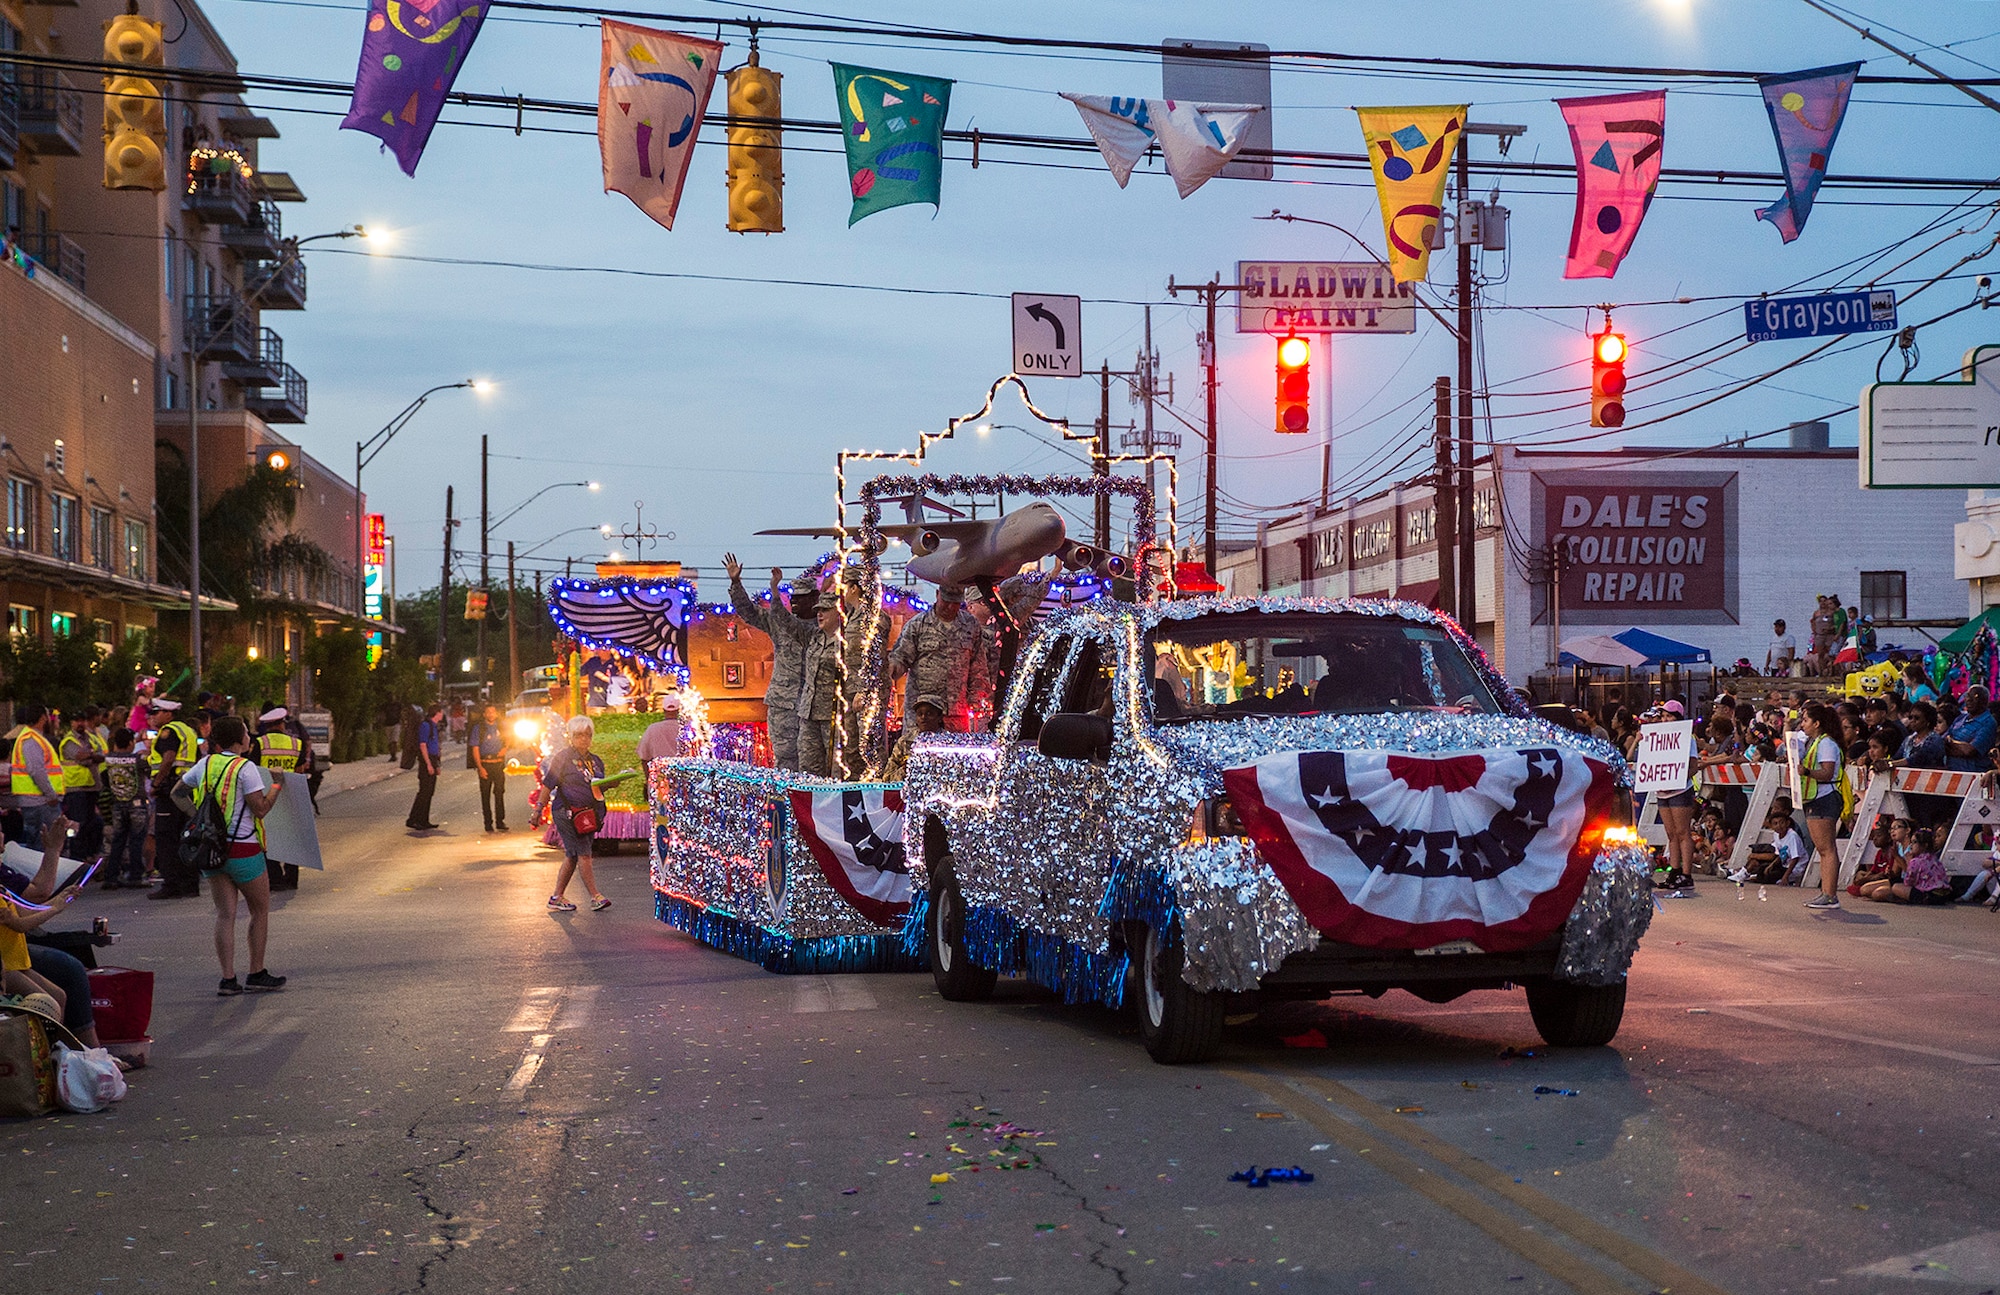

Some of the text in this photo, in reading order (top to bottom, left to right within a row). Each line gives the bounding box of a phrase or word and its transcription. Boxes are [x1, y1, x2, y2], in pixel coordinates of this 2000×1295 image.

[1244, 265, 1409, 298] GLADWIN
[1274, 301, 1383, 327] PAINT
[1751, 298, 1866, 336] E Grayson
[1023, 353, 1071, 370] ONLY
[1561, 495, 1709, 529] DALE'S
[1568, 535, 1706, 565] COLLISION
[1584, 572, 1685, 602] REPAIR
